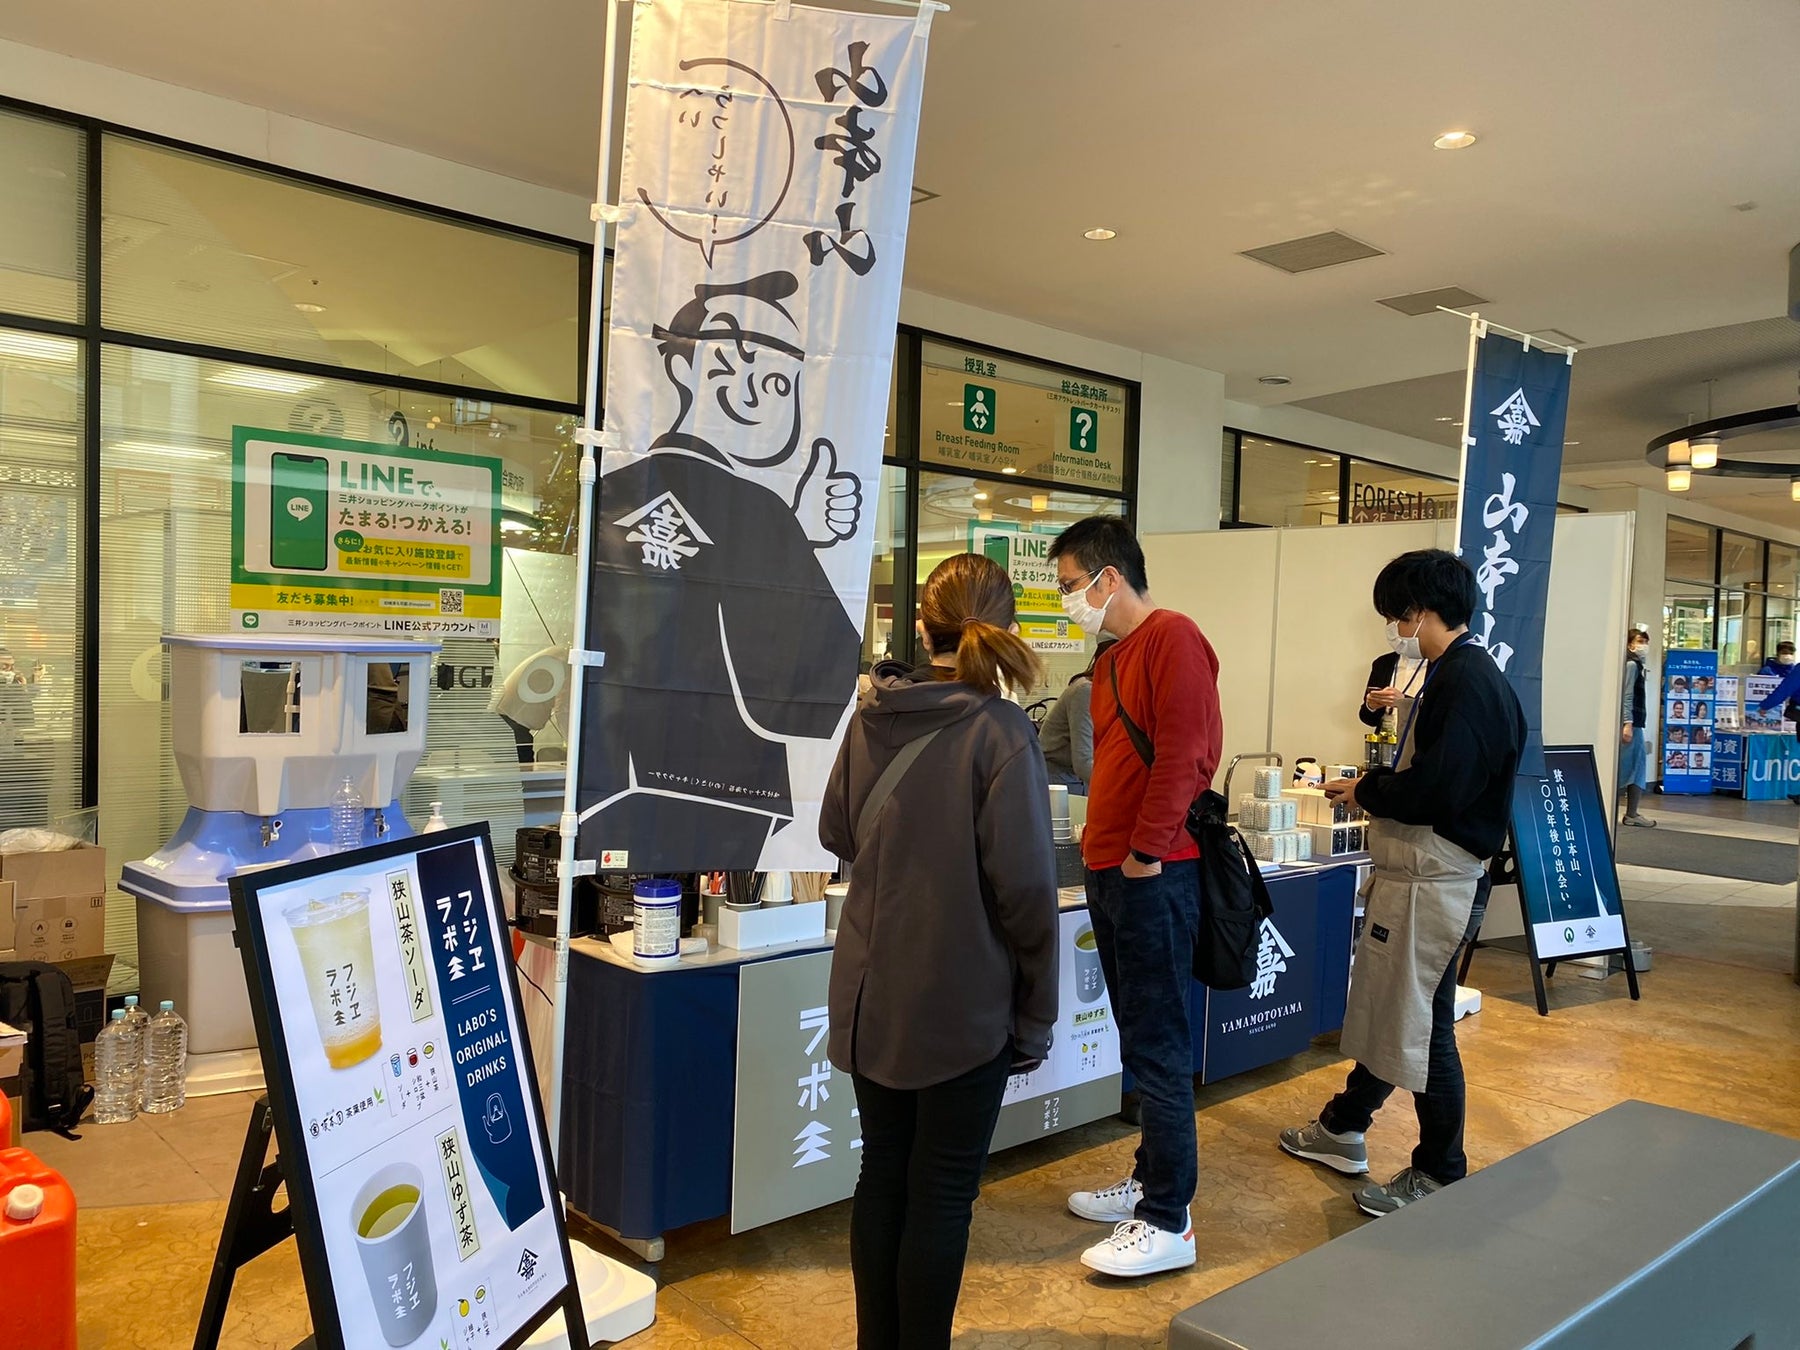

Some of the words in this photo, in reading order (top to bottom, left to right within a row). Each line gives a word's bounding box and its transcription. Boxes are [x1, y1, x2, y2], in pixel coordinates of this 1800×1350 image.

[965, 356, 997, 378] 授乳室
[1061, 380, 1108, 402] 総合案内所
[936, 430, 963, 446] Breast
[965, 436, 996, 453] Feeding
[998, 441, 1020, 455] Room
[1052, 451, 1094, 468] Information
[1095, 459, 1112, 471] Desk
[290, 504, 309, 513] LINE
[338, 494, 469, 514] 三井ショッピングパークポイントが
[338, 507, 471, 536] たまる!つかえる!
[1014, 538, 1048, 559] LINE
[1476, 472, 1529, 673] 山本山
[277, 591, 354, 607] 友だち募集中!
[384, 620, 476, 632] LINE公式アカウント
[1552, 769, 1582, 877] 狭山茶と山本山、
[436, 896, 459, 953] ラボ
[392, 879, 425, 1011] 狭山茶ソーダ
[326, 968, 342, 1007] ラボ
[457, 1008, 497, 1038] LABO'S
[1221, 1001, 1303, 1034] YAMAMOTOYAMA
[456, 1030, 508, 1066] ORIGINAL
[798, 1006, 832, 1111] ラボ
[466, 1055, 507, 1088] DRINKS
[441, 1137, 474, 1249] 狭山ゆず茶
